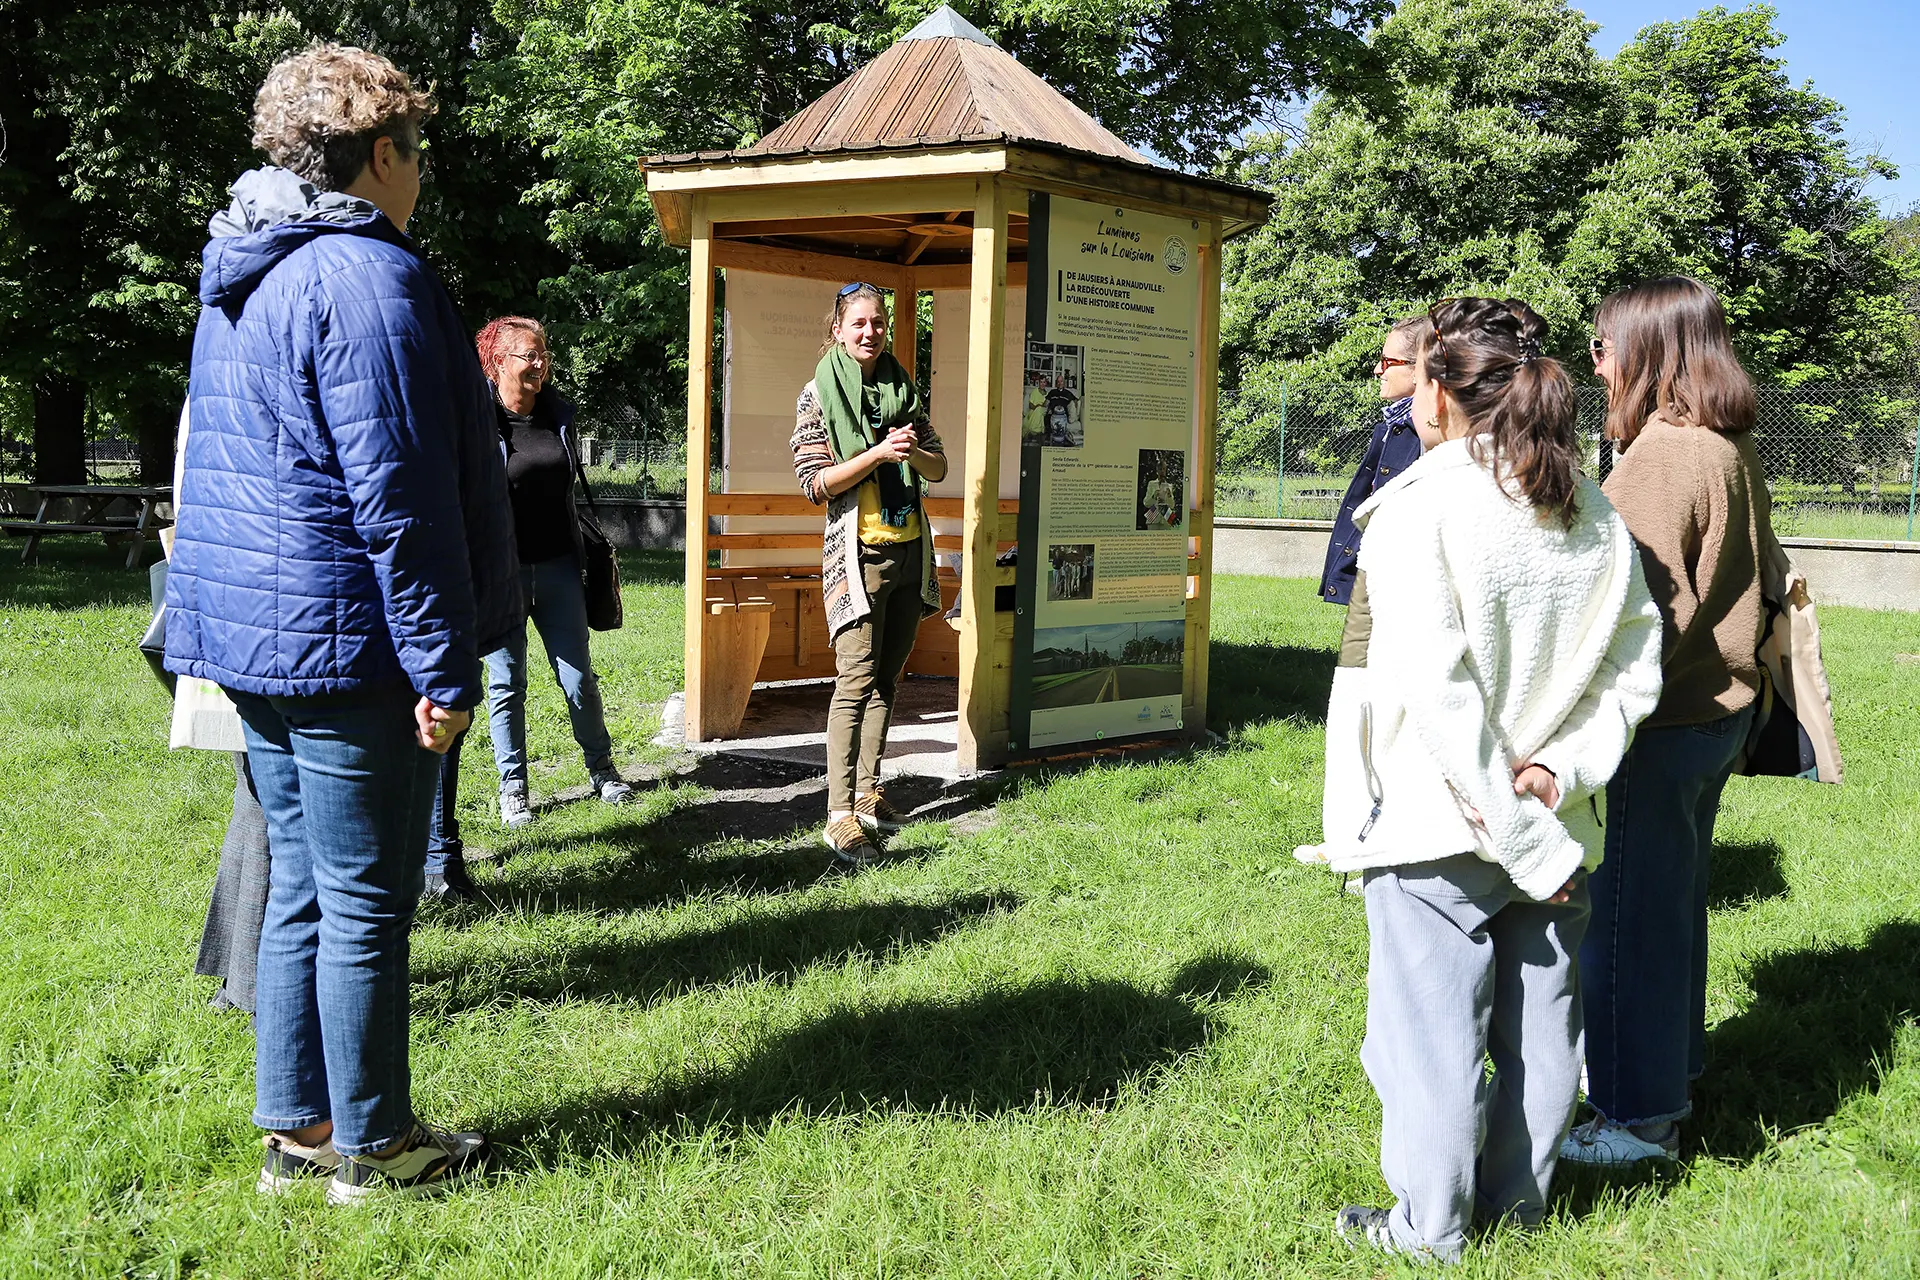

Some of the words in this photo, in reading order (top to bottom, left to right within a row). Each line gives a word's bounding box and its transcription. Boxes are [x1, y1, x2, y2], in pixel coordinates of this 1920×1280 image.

[1097, 220, 1141, 243] Lumières
[1080, 241, 1097, 254] sur
[1100, 242, 1109, 255] la
[1112, 242, 1155, 263] Louisiane
[1066, 284, 1076, 293] LA
[1077, 284, 1130, 300] REDÉCOUVERTE
[1067, 271, 1077, 281] DE
[1077, 272, 1109, 285] JAUSIERS
[1109, 273, 1115, 286] À
[1116, 277, 1162, 293] ARNAUDVILLE
[1066, 294, 1088, 306] D'UNE
[1088, 297, 1120, 310] HISTOIRE
[1120, 301, 1155, 314] COMMUNE
